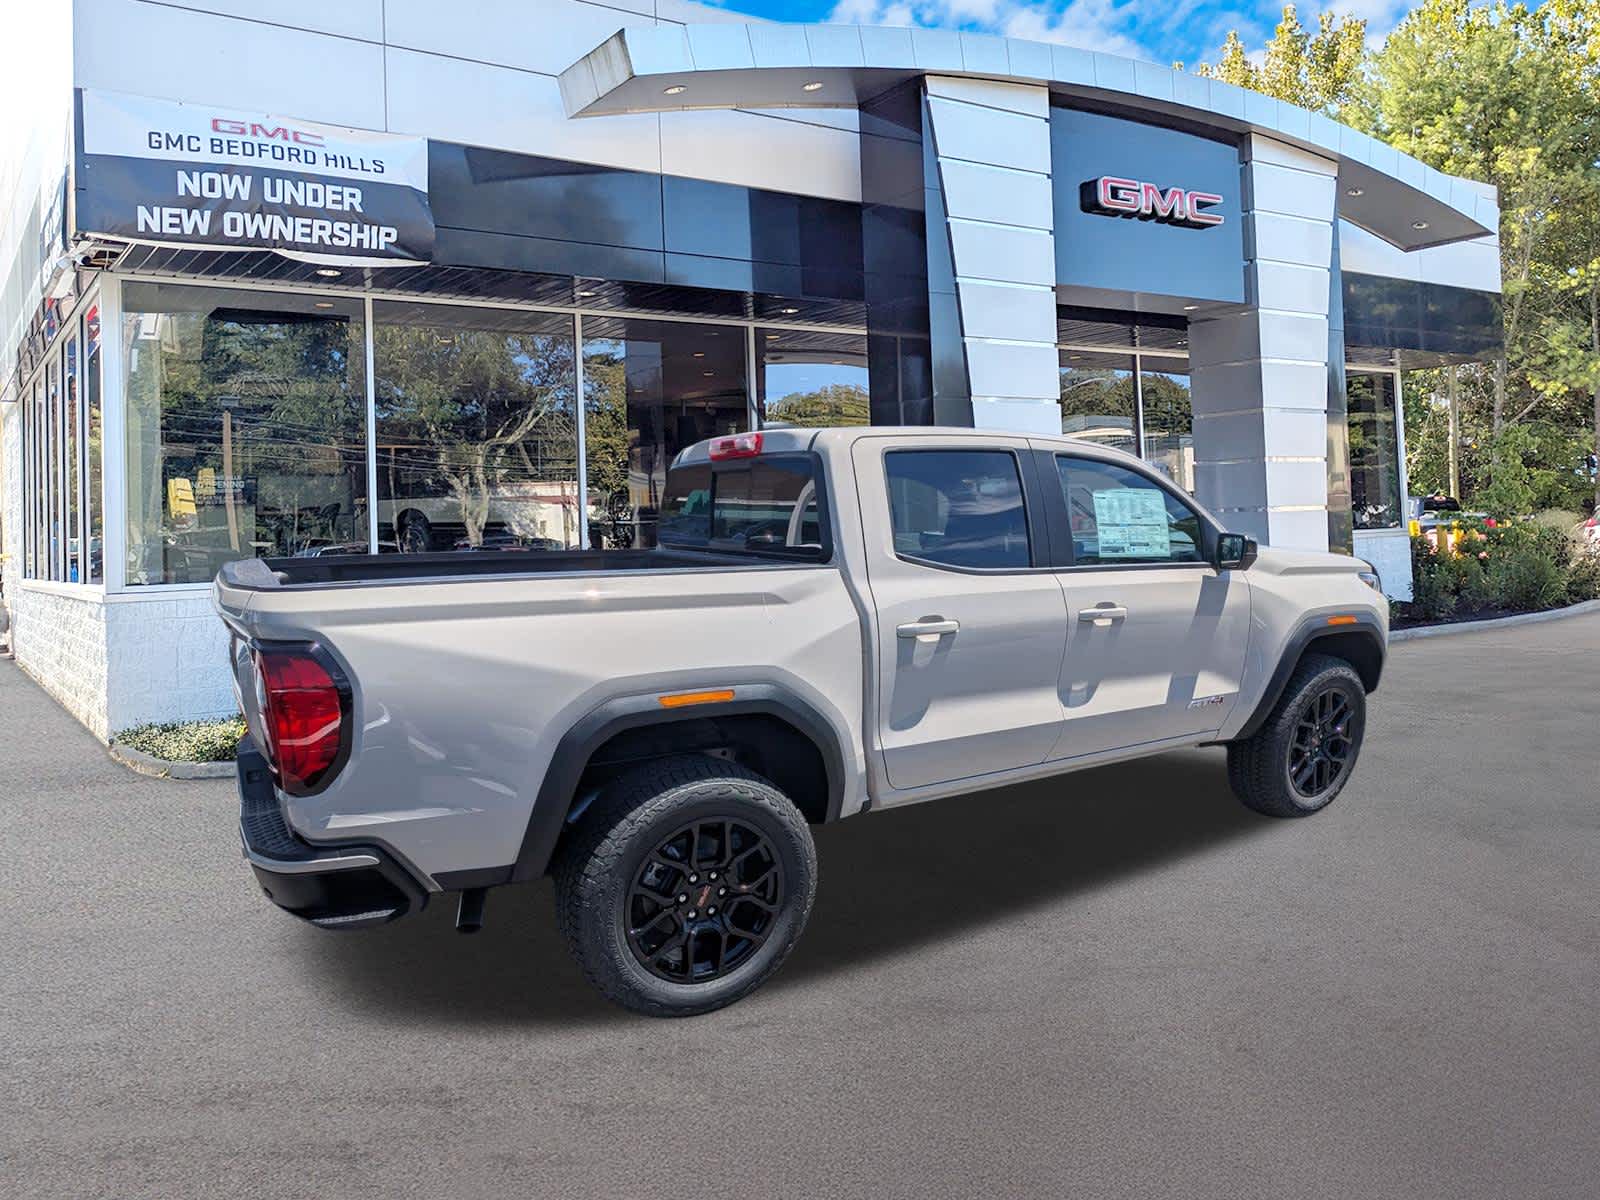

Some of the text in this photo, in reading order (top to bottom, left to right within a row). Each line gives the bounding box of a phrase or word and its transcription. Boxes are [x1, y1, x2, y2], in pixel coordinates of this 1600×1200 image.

[148, 131, 385, 174] GMC BEDFORD HILLS
[210, 118, 326, 148] GMC
[176, 170, 364, 213] NOW UNDER
[1096, 175, 1225, 225] GMC
[136, 205, 398, 250] NEW OWNERSHIP
